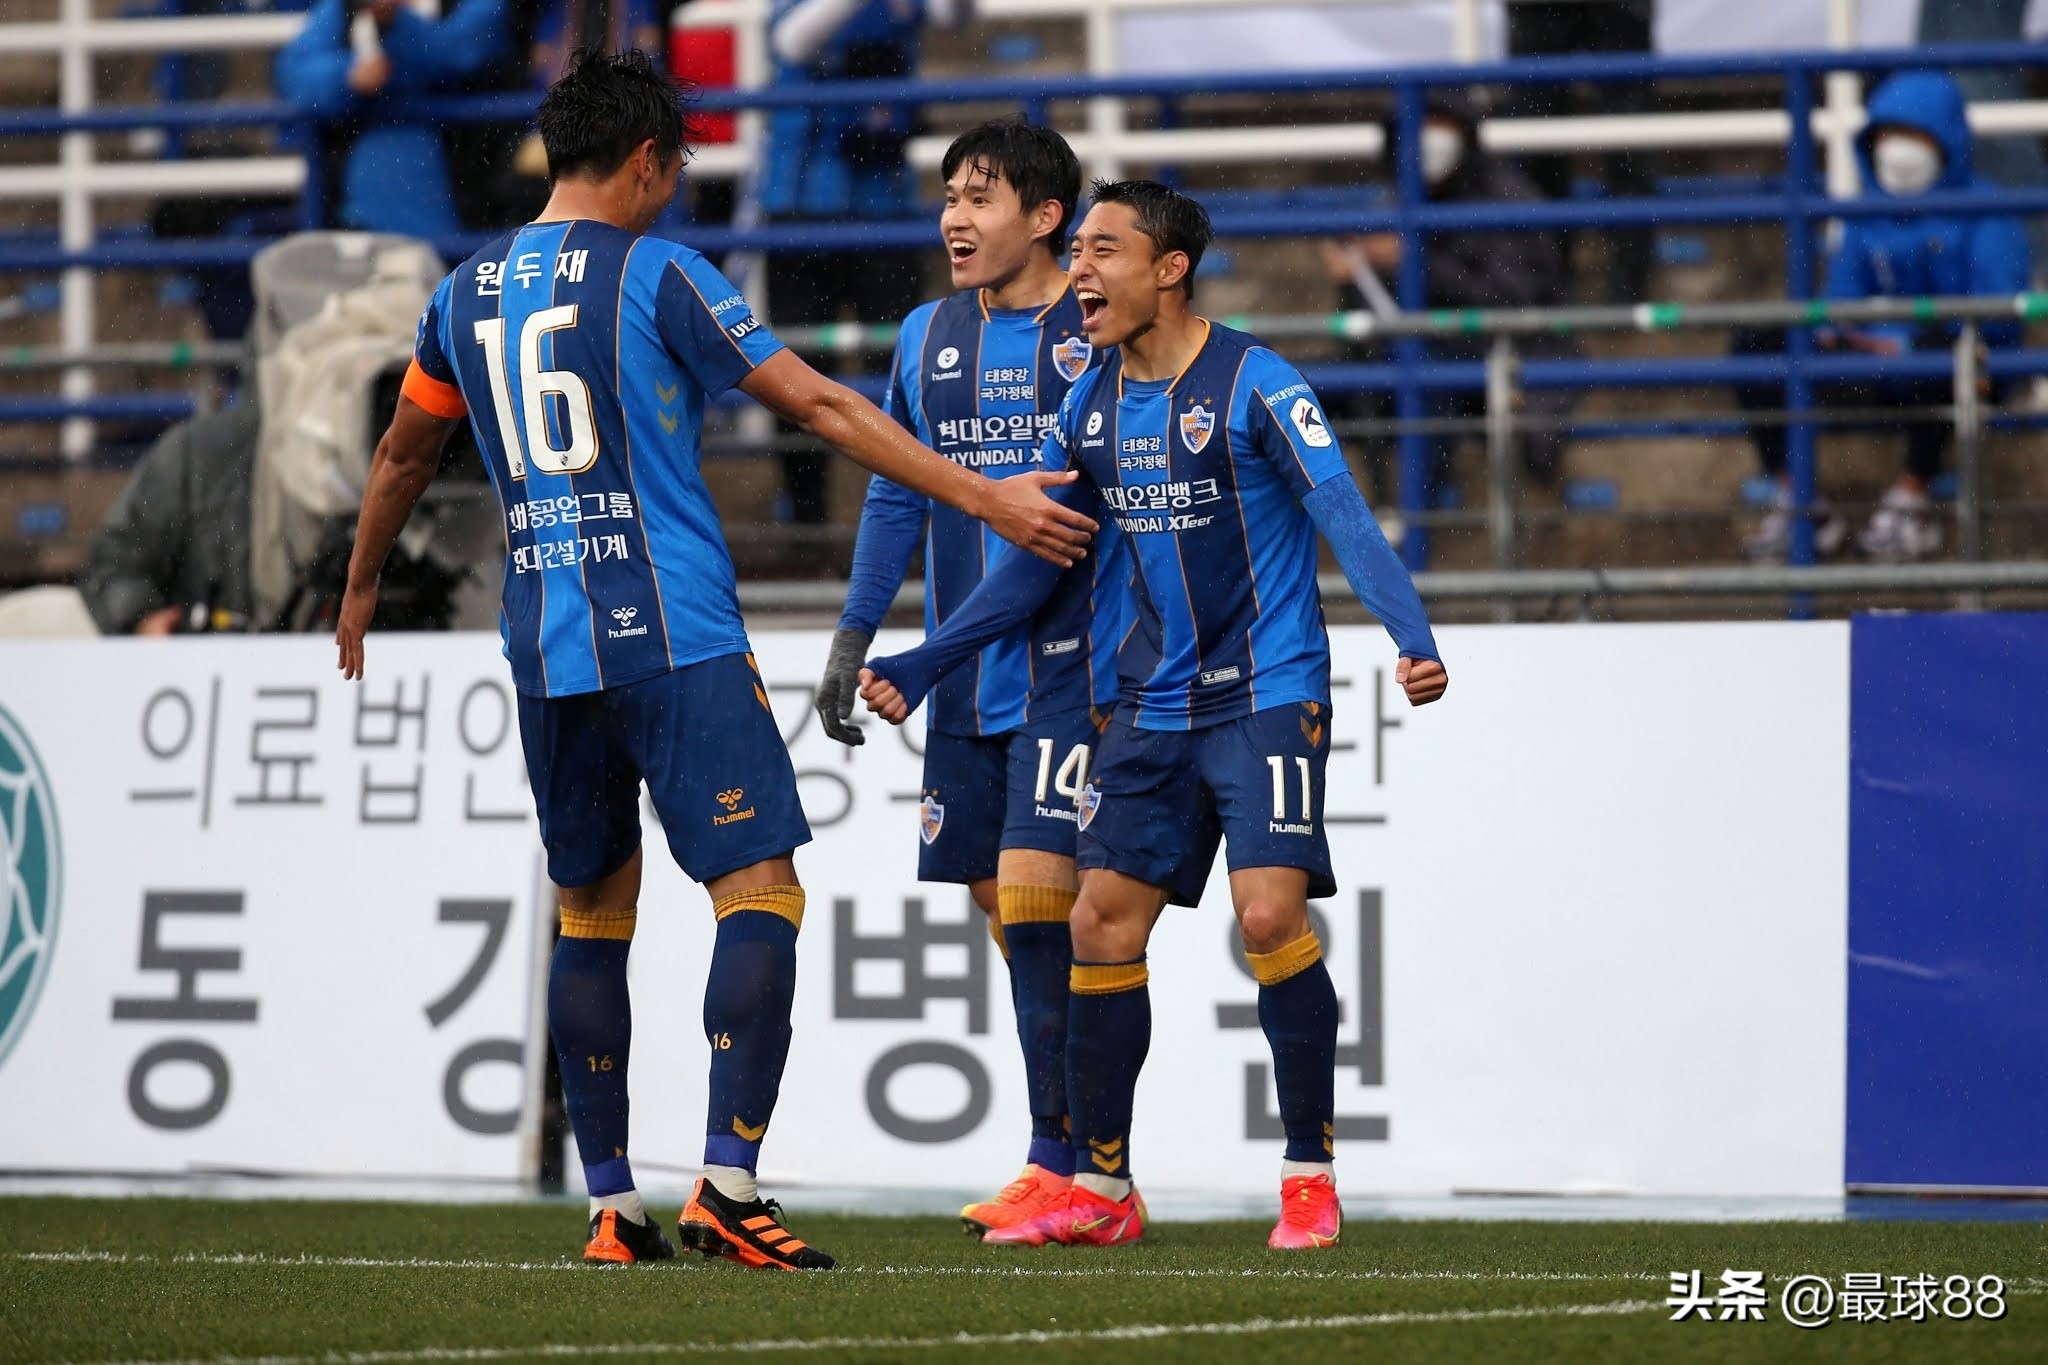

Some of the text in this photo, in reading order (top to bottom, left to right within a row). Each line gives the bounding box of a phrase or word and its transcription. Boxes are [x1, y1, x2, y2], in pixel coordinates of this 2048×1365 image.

[475, 249, 589, 297] 원두재
[931, 369, 962, 382] hummel
[984, 367, 1030, 384] 태화강
[473, 304, 599, 482] 16
[980, 385, 1035, 402] 국가정원
[938, 413, 1059, 446] 현대오일뱅
[1184, 421, 1210, 431] HYUNDAI
[1122, 437, 1162, 453] 태화강
[1119, 454, 1167, 471] 국가정원
[1115, 516, 1163, 533] YUNDAI
[608, 625, 648, 639] hummel
[1034, 738, 1090, 808] 14
[1266, 755, 1311, 821] 11
[713, 806, 755, 826] hummel
[1035, 804, 1078, 822] humme
[1269, 820, 1313, 836] hummel
[713, 1032, 732, 1050] 16
[587, 1055, 613, 1073] 16
